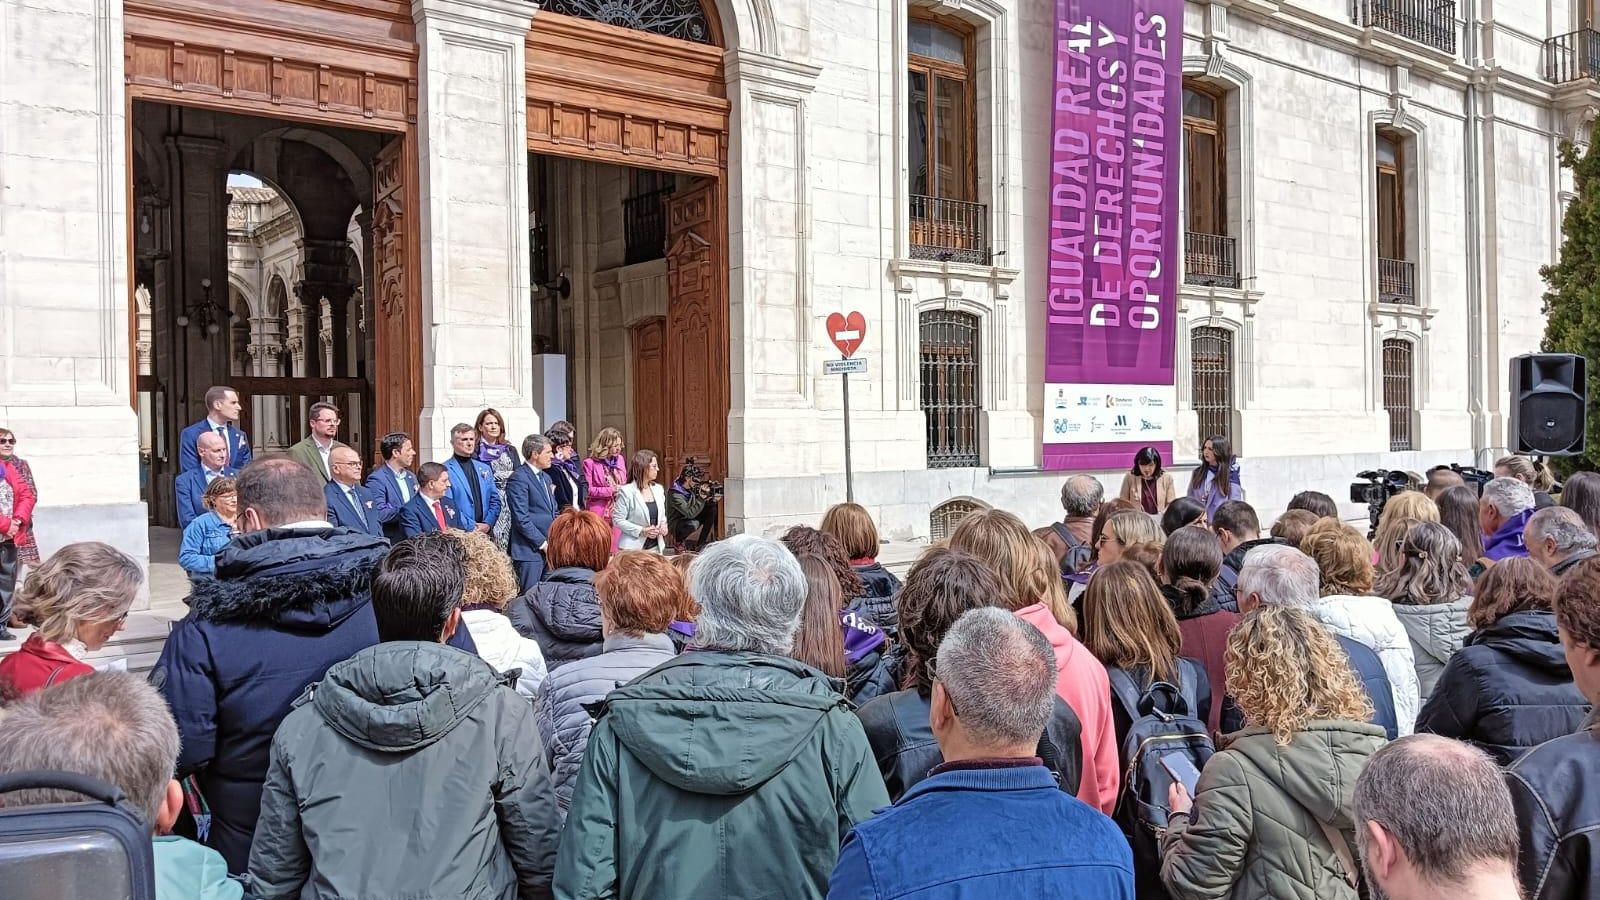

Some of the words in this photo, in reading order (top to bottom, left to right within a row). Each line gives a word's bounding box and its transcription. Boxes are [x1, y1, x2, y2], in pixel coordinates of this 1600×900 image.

[1056, 15, 1091, 115] REAL
[1098, 21, 1128, 47] Y
[1049, 128, 1089, 325] IGUALDAD
[1094, 56, 1127, 265] DERECHOS
[1128, 11, 1167, 330] OPORTUNIDADES
[1090, 277, 1121, 328] DE
